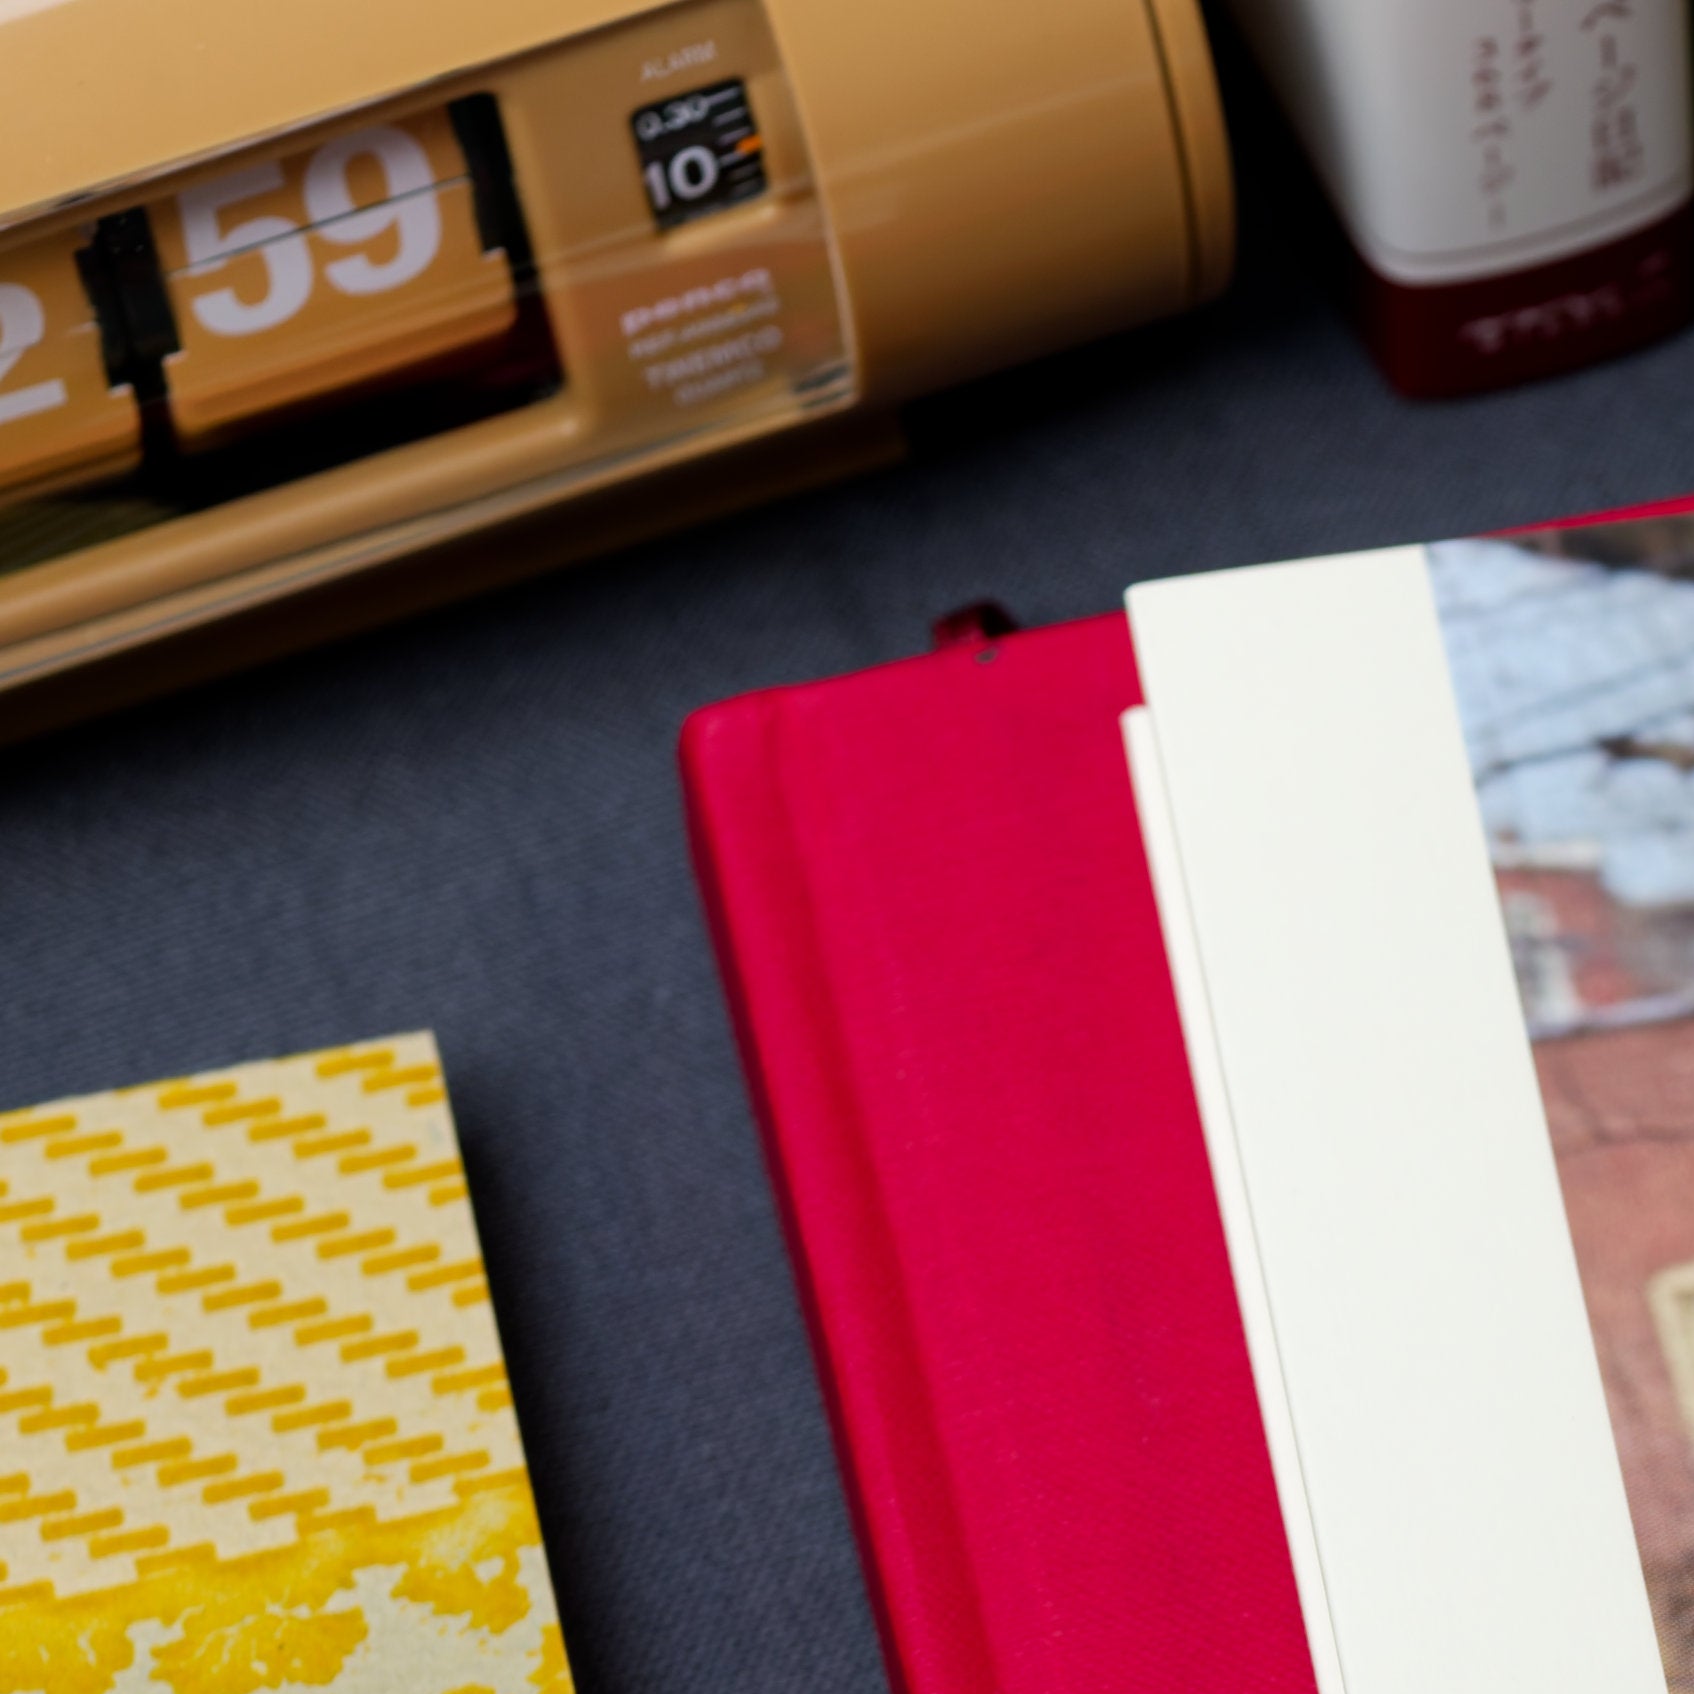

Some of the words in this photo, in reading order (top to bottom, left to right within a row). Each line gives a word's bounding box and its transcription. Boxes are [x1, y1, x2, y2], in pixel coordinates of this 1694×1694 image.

[640, 40, 717, 82] ALARM
[645, 145, 718, 209] 10
[177, 126, 443, 336] 59
